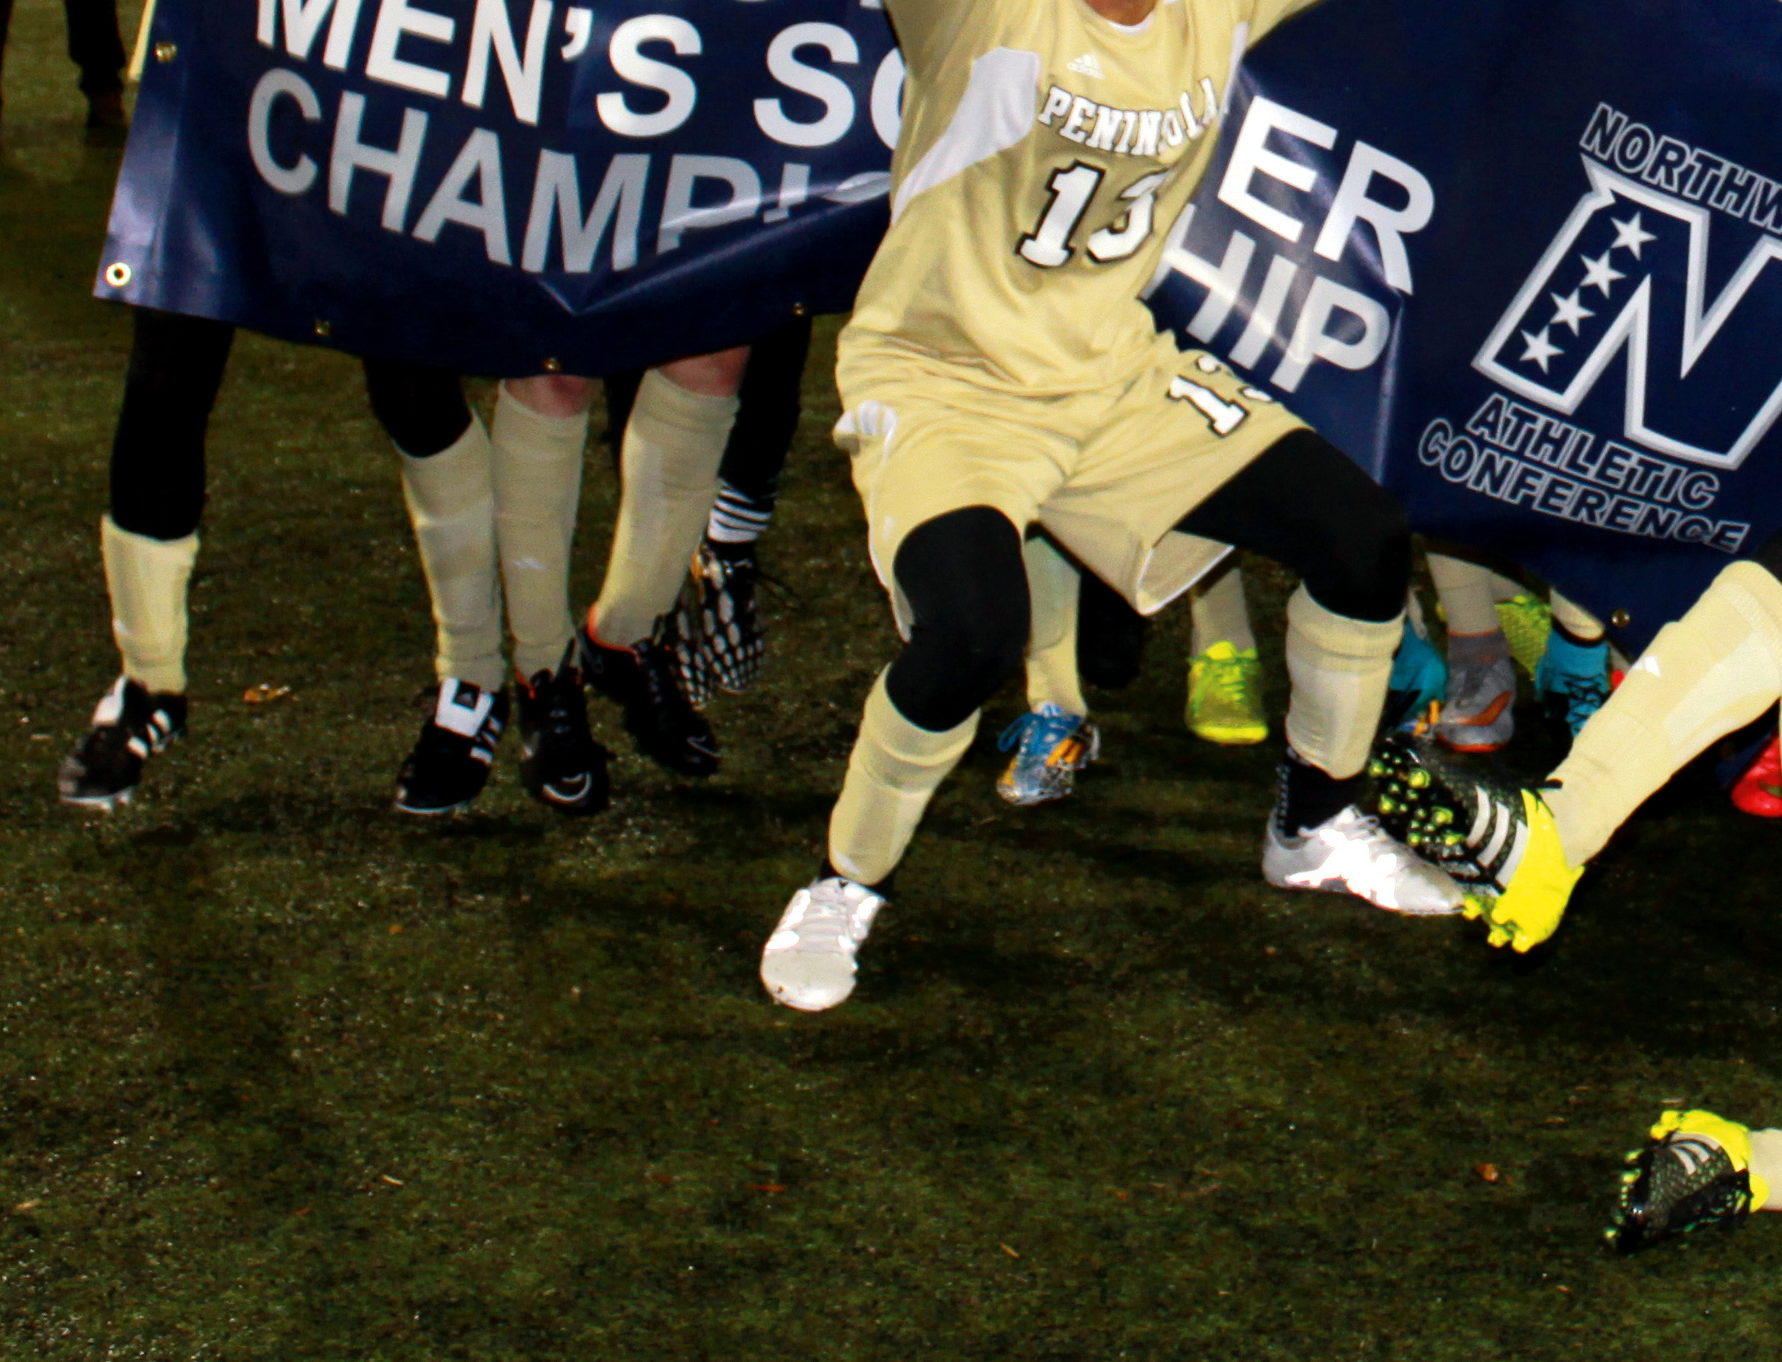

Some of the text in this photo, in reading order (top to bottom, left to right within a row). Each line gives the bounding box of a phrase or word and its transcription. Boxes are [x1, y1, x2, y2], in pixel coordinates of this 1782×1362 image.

[1014, 158, 1172, 270] 13
[1417, 416, 1751, 555] CONFERENCE
[1464, 392, 1721, 510] ATHLETIC
